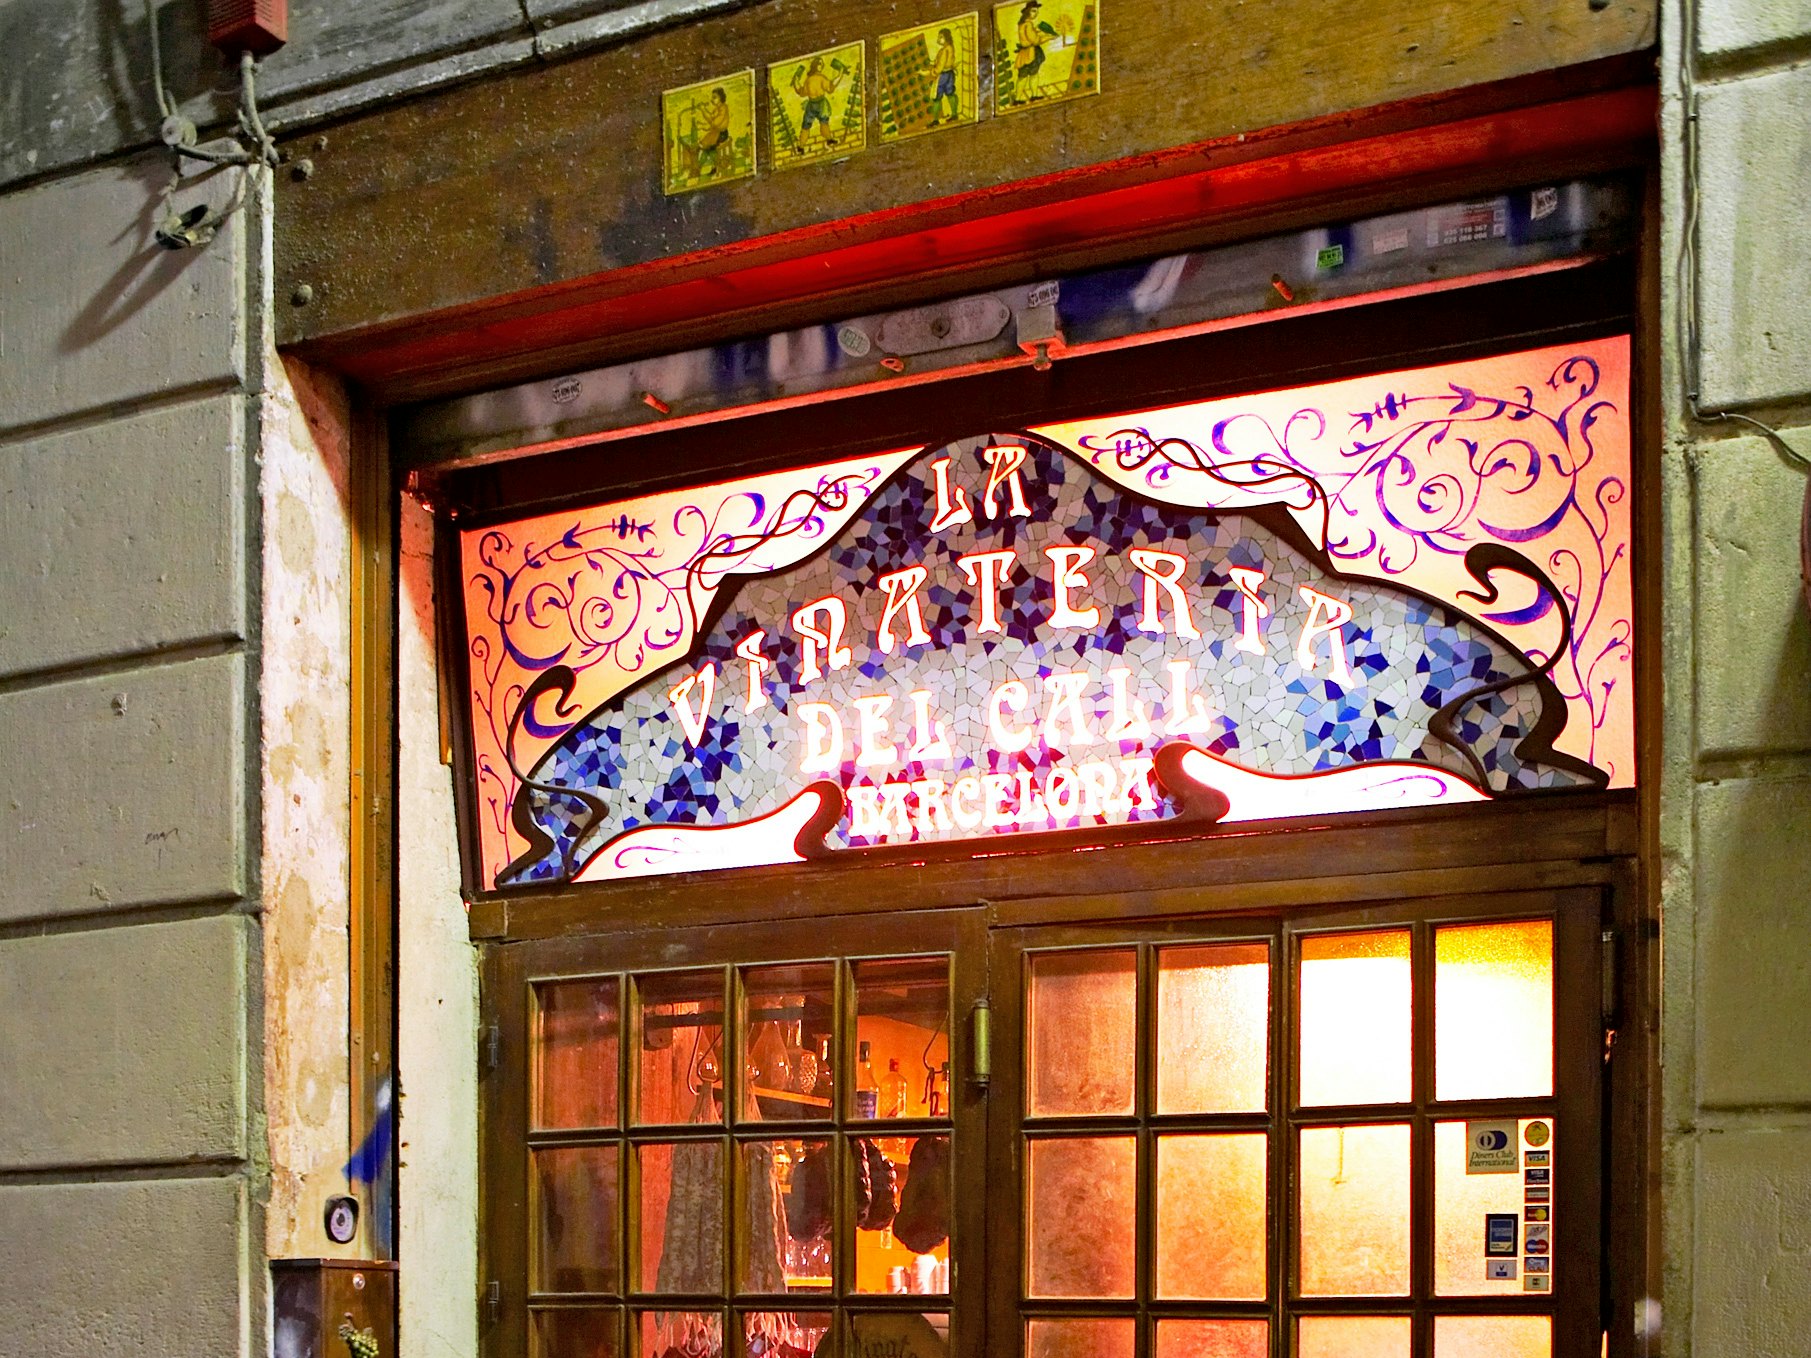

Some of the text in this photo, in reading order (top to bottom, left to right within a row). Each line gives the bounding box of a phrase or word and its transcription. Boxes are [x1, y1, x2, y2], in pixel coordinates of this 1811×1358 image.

[930, 445, 1031, 533] LA
[668, 545, 1354, 749] VINATERIA
[797, 661, 1211, 774] DEL CALL
[847, 758, 1159, 838] BARCELONA
[1469, 1157, 1516, 1167] International
[1496, 1149, 1514, 1158] Club
